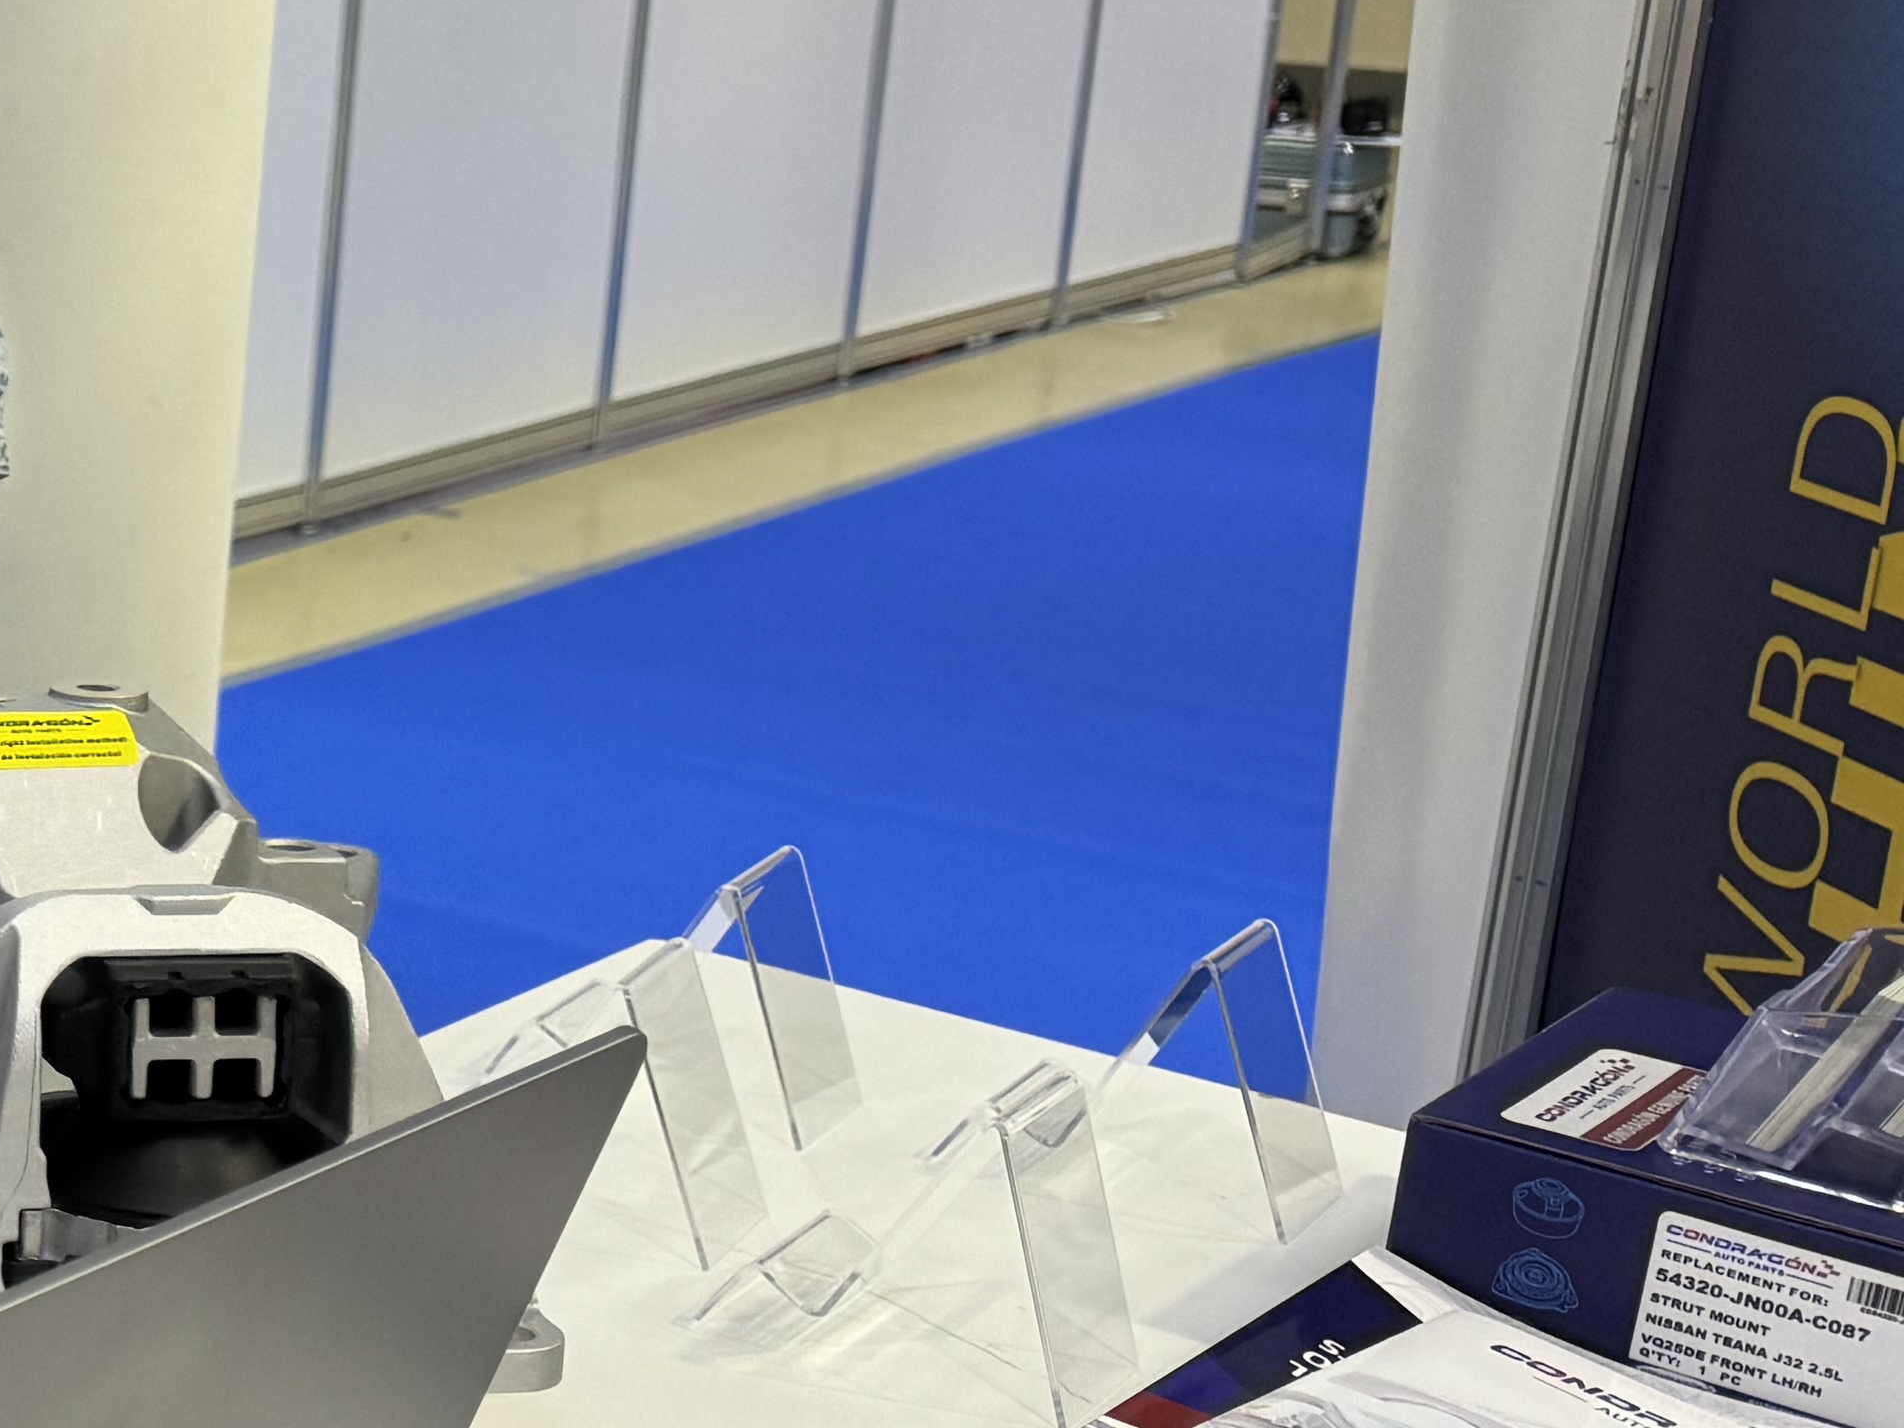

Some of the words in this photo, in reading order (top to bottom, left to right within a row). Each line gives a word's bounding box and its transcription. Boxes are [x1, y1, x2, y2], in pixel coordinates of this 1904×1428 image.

[1703, 395, 1896, 1026] WORLD
[1661, 1248, 1786, 1293] REPLACEMENT
[1788, 1286, 1830, 1308] FOR:
[1666, 1223, 1818, 1278] CONDRAGÓN
[1714, 1251, 1745, 1265] AUTO
[1748, 1260, 1785, 1277] PARTS
[1650, 1292, 1706, 1317] STRUT
[1709, 1308, 1772, 1337] MOUNT
[1655, 1267, 1872, 1343] 54320-JN00A-C087
[1639, 1346, 1681, 1368] Q'TY:
[1699, 1365, 1706, 1376] 1
[1720, 1371, 1742, 1387] PC
[1641, 1332, 1707, 1362] VQ25DE
[1710, 1353, 1767, 1381] FRONT
[1771, 1372, 1823, 1398] LH/RH
[1645, 1312, 1708, 1341] NISSAN
[1712, 1332, 1768, 1359] TEANA
[1773, 1351, 1804, 1370] J32
[1808, 1362, 1844, 1383] 2.5L
